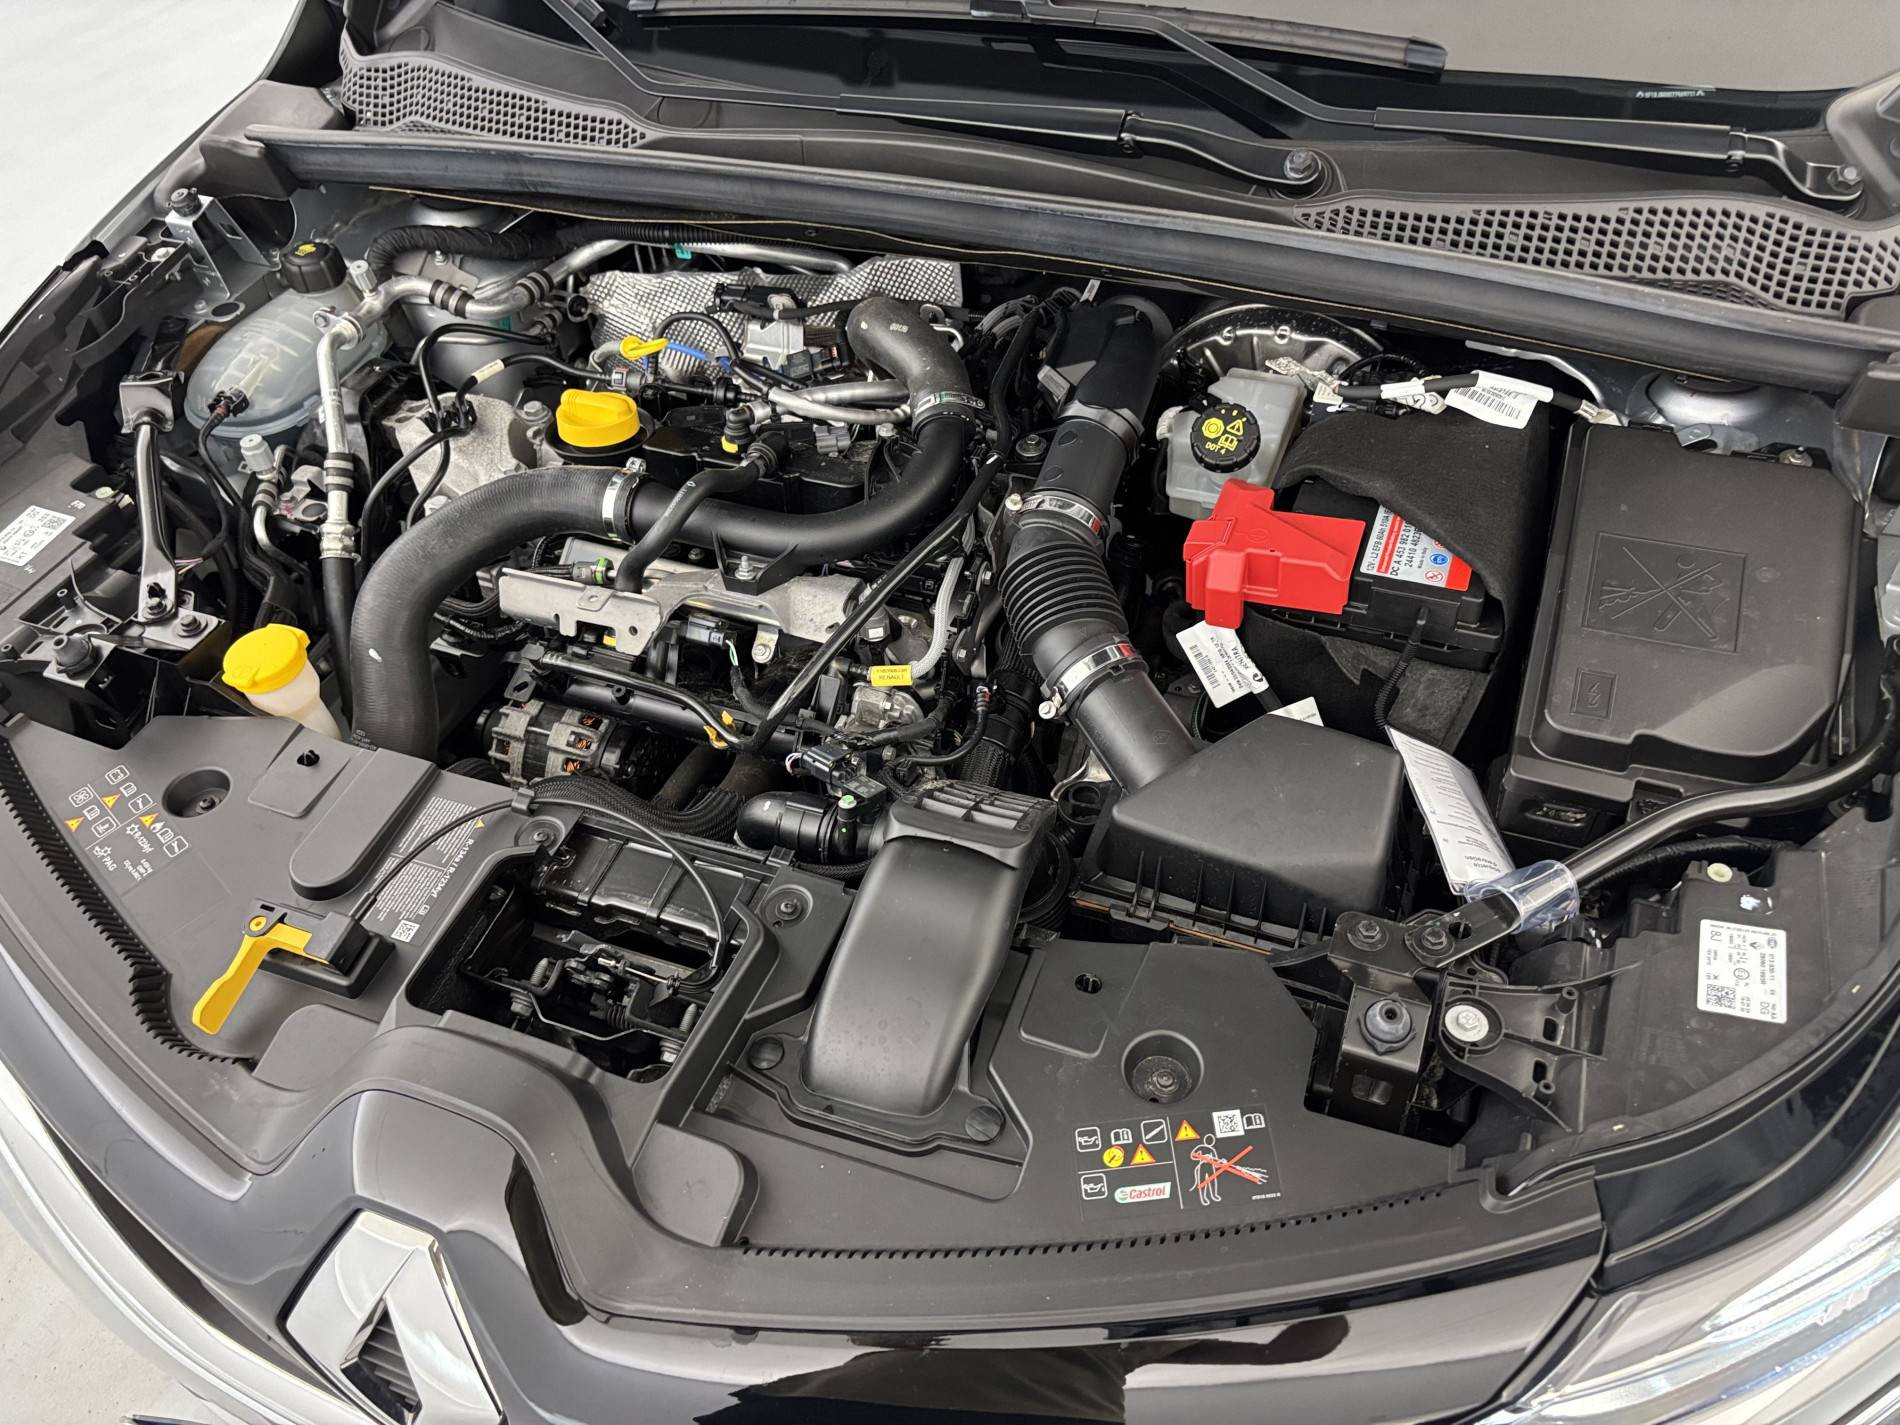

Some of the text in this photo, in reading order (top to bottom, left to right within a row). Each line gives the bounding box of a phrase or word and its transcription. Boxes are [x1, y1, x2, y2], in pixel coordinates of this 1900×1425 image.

[1205, 442, 1220, 452] DOT
[1390, 566, 1400, 576] DC
[1396, 546, 1405, 558] 453
[1404, 547, 1417, 568] 24410
[102, 856, 117, 871] PAG
[1128, 1184, 1166, 1200] Castrol
